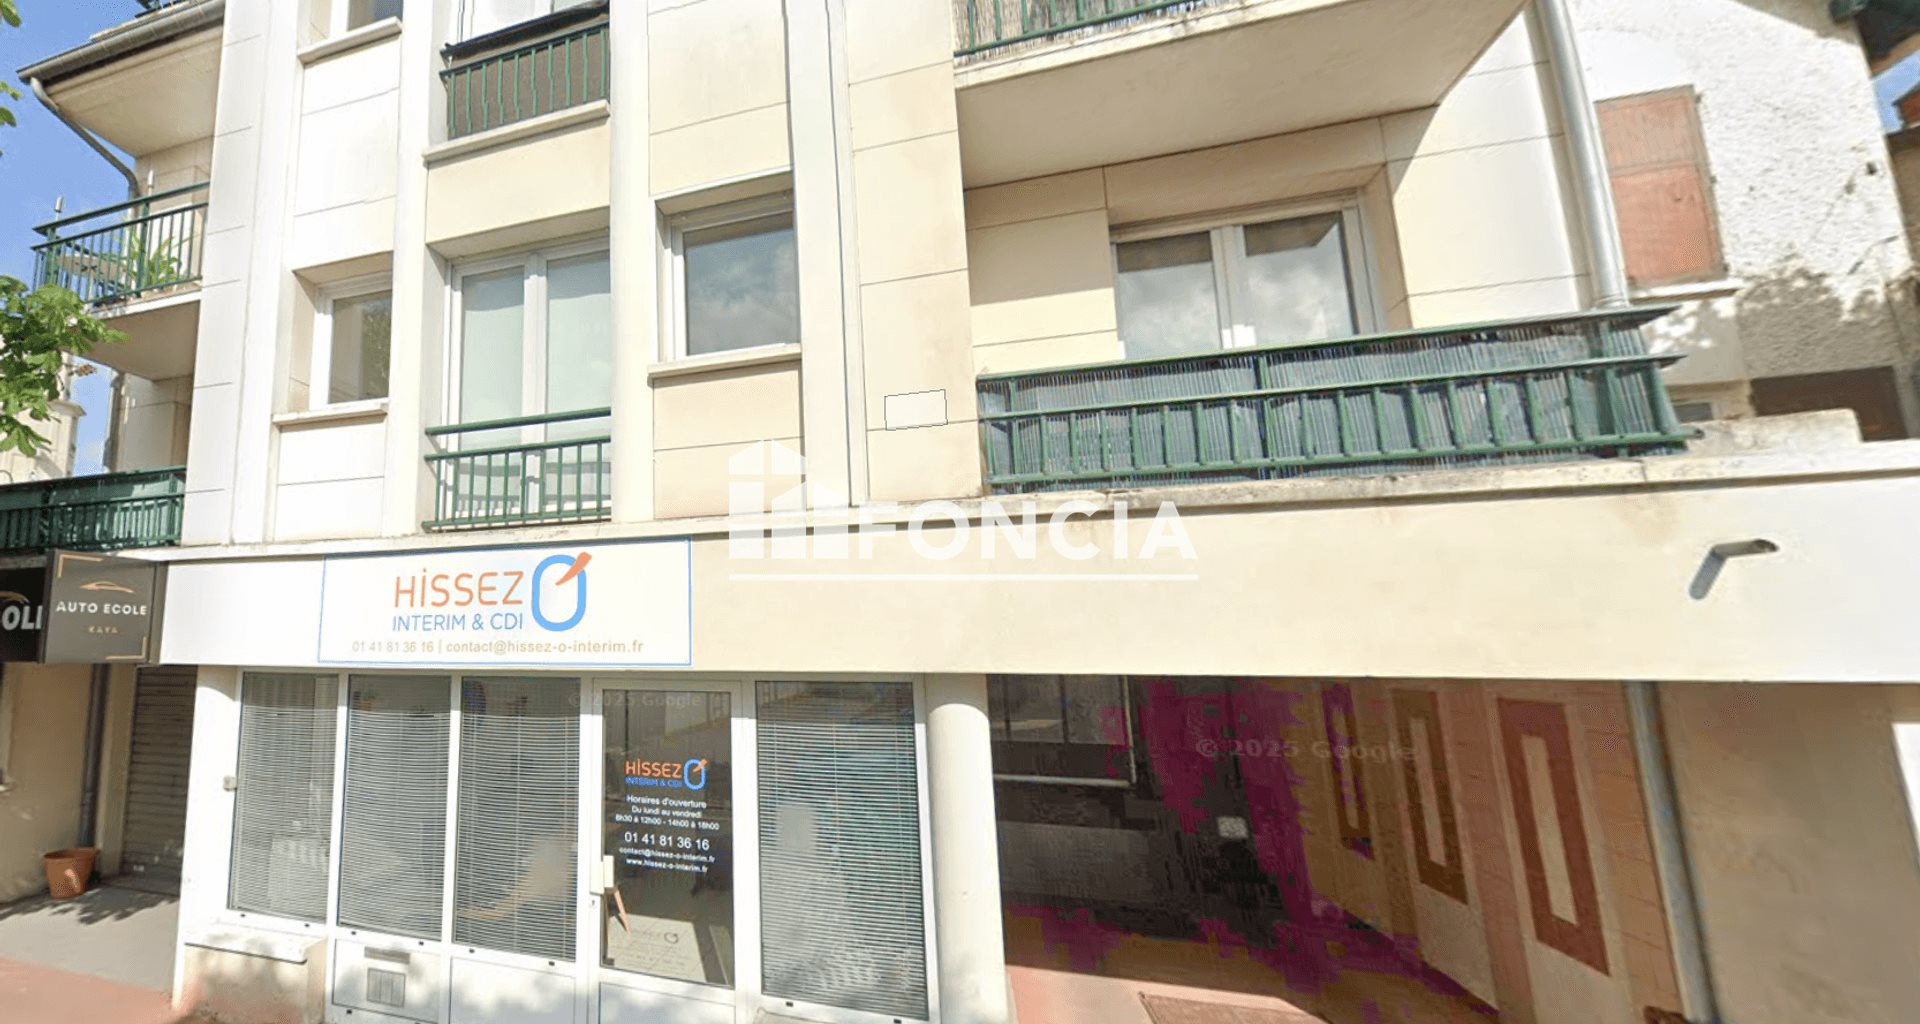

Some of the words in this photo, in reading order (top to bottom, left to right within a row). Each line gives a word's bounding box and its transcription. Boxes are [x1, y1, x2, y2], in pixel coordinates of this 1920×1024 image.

[56, 601, 98, 613] AUTO
[103, 603, 148, 615] ECOLE
[392, 615, 465, 632] INTERIM
[490, 613, 524, 630] CDI
[352, 643, 366, 653] 01
[369, 643, 383, 653] 41
[386, 643, 400, 653] 81
[402, 643, 417, 653] 36
[421, 643, 434, 653] 16
[446, 641, 644, 655] contact@hissez-o-interim.fr
[626, 795, 660, 805] Horaires
[662, 797, 707, 808] d'ouverture
[643, 806, 660, 814] lundi
[672, 809, 702, 818] vendredi
[615, 814, 632, 822] 8h30
[640, 816, 661, 825] 12h00
[668, 819, 689, 827] 14h00
[698, 822, 720, 830] 18h00
[624, 831, 638, 843] 01
[641, 833, 655, 845] 41
[659, 834, 673, 847] 81
[677, 836, 692, 849] 36
[696, 838, 710, 851] 16
[618, 846, 716, 863] contact@hissez-o-interim.fr
[625, 857, 708, 873] www.hissez-o-interim.fr
